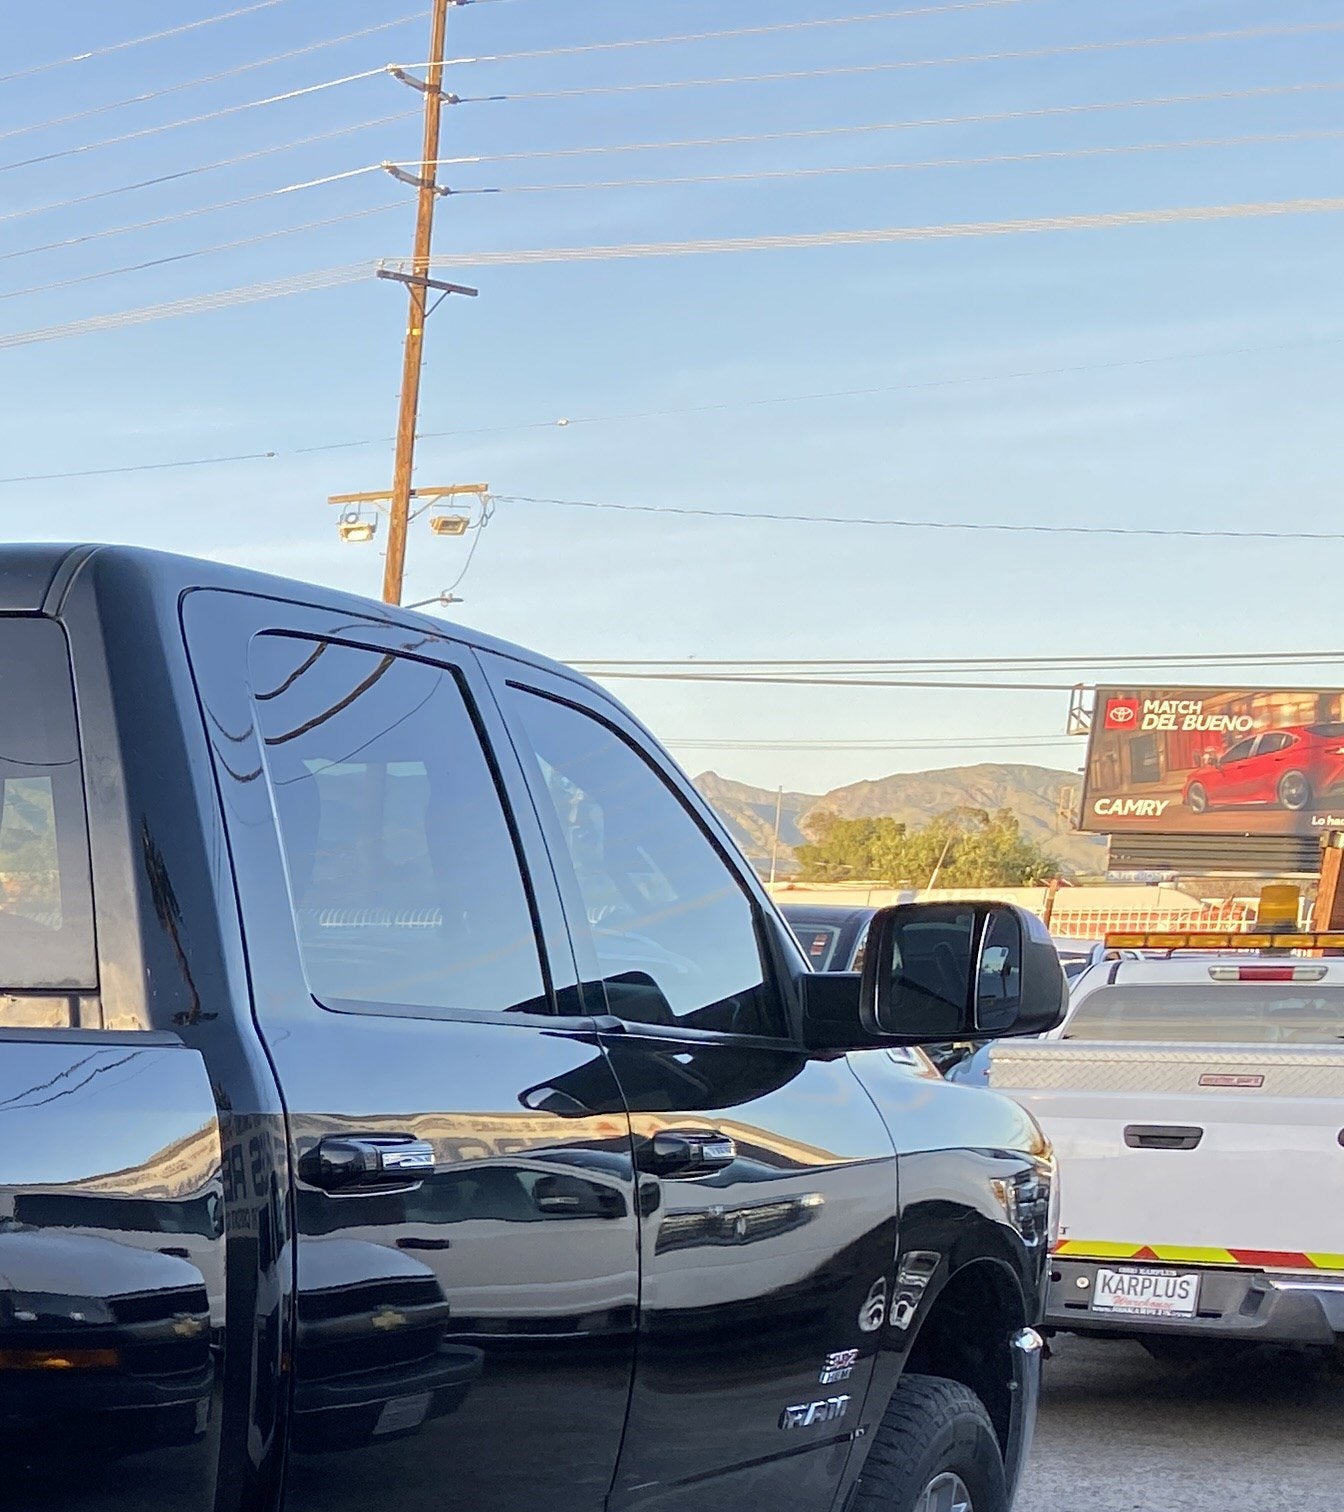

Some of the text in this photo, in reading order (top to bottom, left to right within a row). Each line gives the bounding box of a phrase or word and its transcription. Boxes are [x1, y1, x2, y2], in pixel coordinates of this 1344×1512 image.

[1143, 700, 1202, 715] MATCH
[1141, 713, 1253, 732] DEL BUENO
[1094, 799, 1170, 816] CAMRY
[1101, 1274, 1191, 1299] KARPLUS
[779, 1394, 851, 1430] RAM
